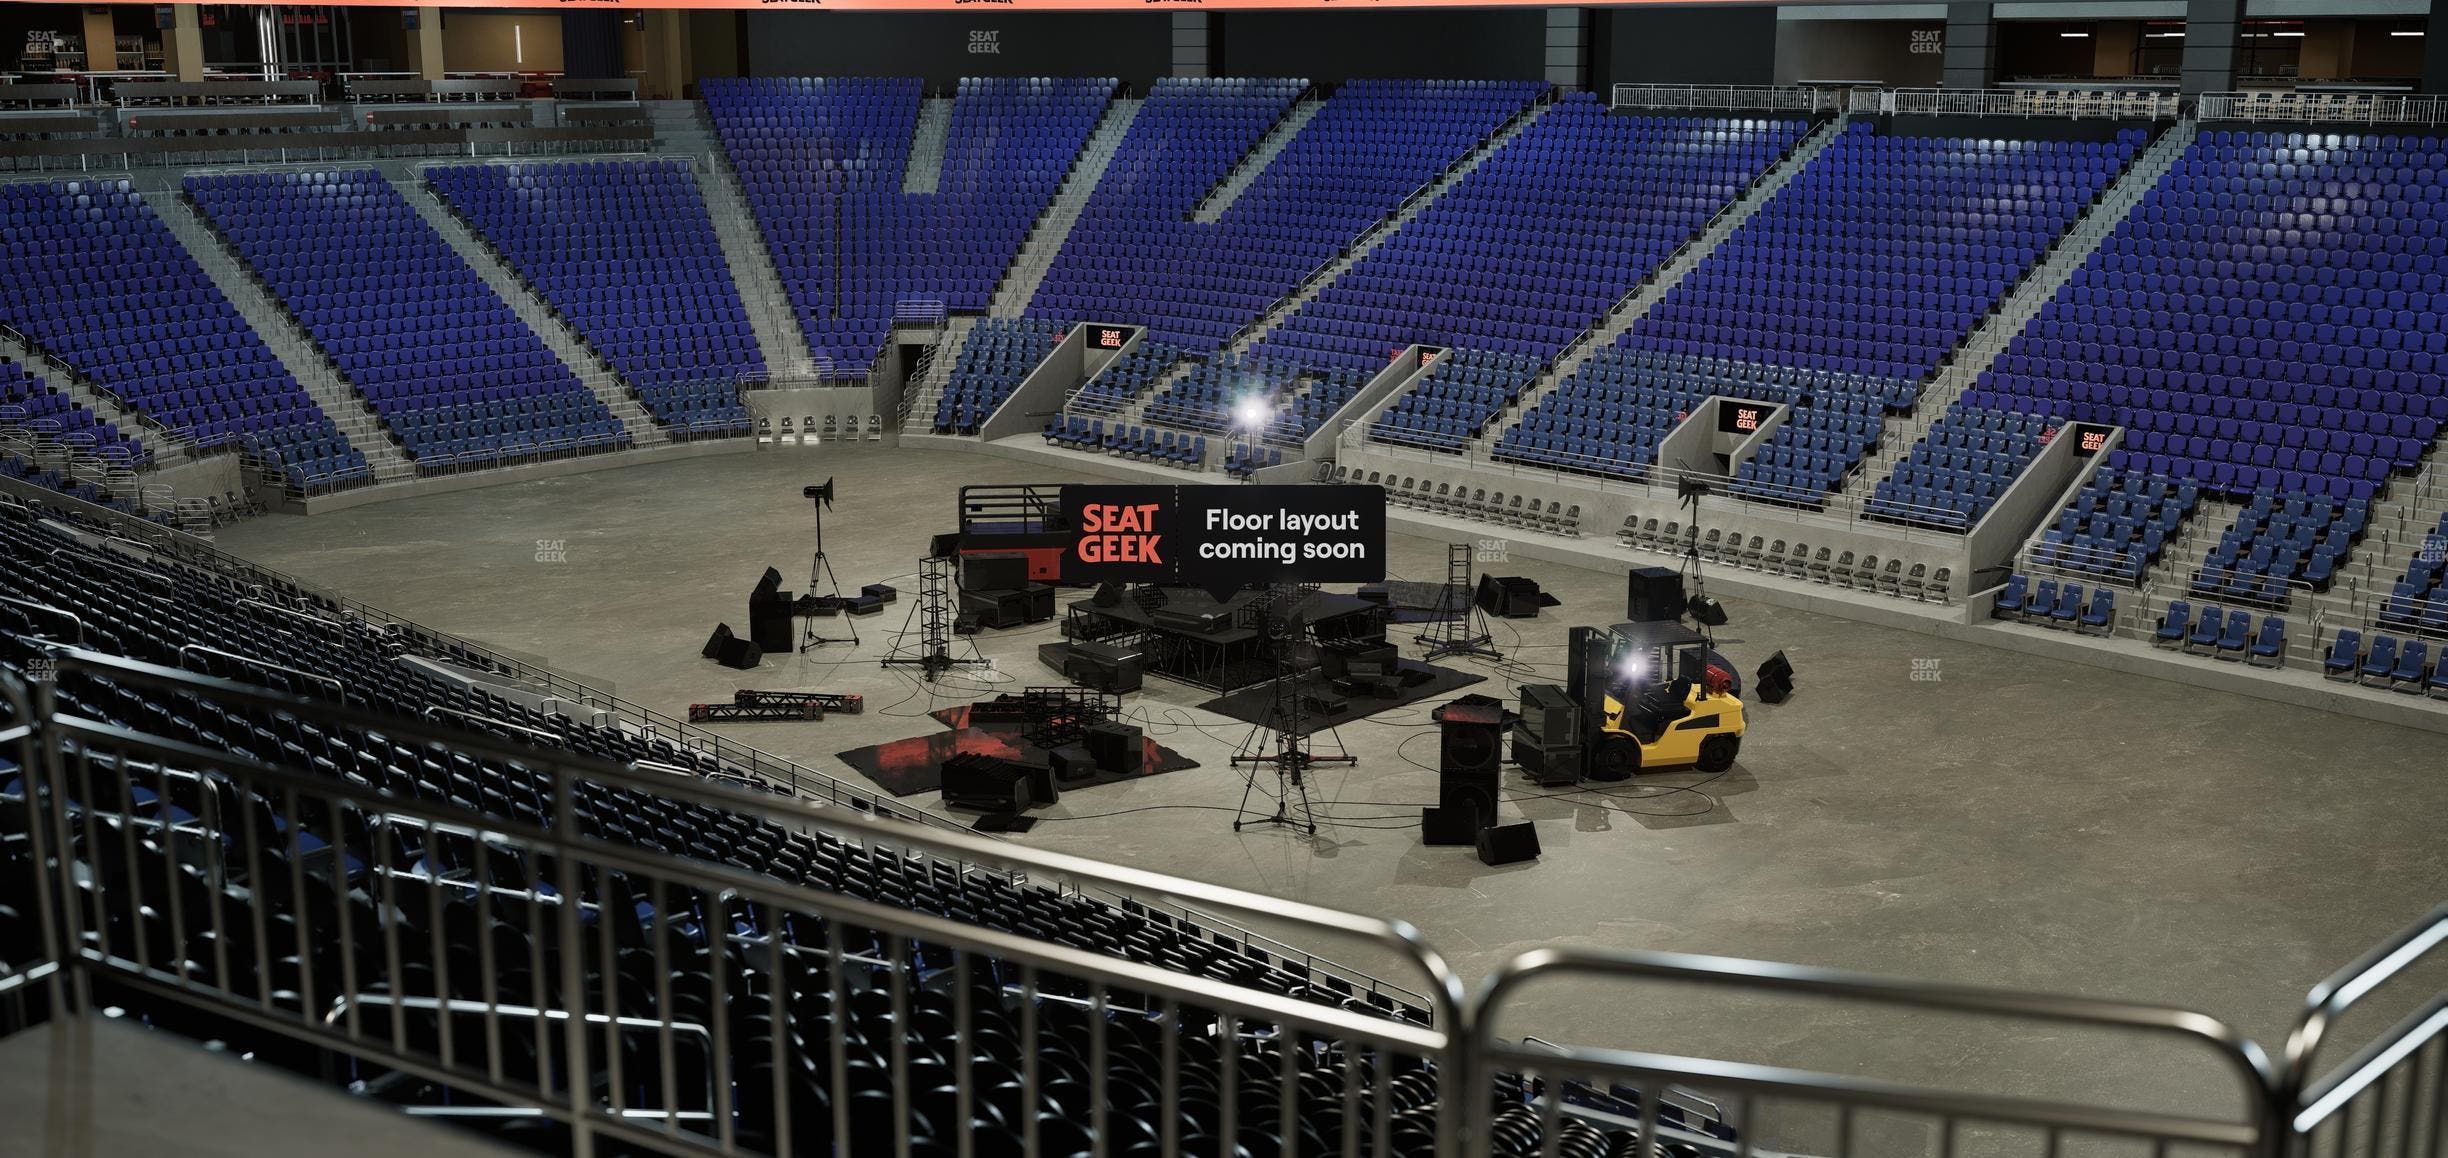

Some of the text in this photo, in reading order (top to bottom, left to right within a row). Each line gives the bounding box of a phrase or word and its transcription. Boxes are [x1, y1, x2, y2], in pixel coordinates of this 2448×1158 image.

[1101, 329, 1121, 339] SEAT
[1100, 337, 1121, 347] GEEK
[1738, 408, 1758, 420] SEAT
[1736, 419, 1757, 431] GEEK
[2083, 431, 2106, 443] SEAT
